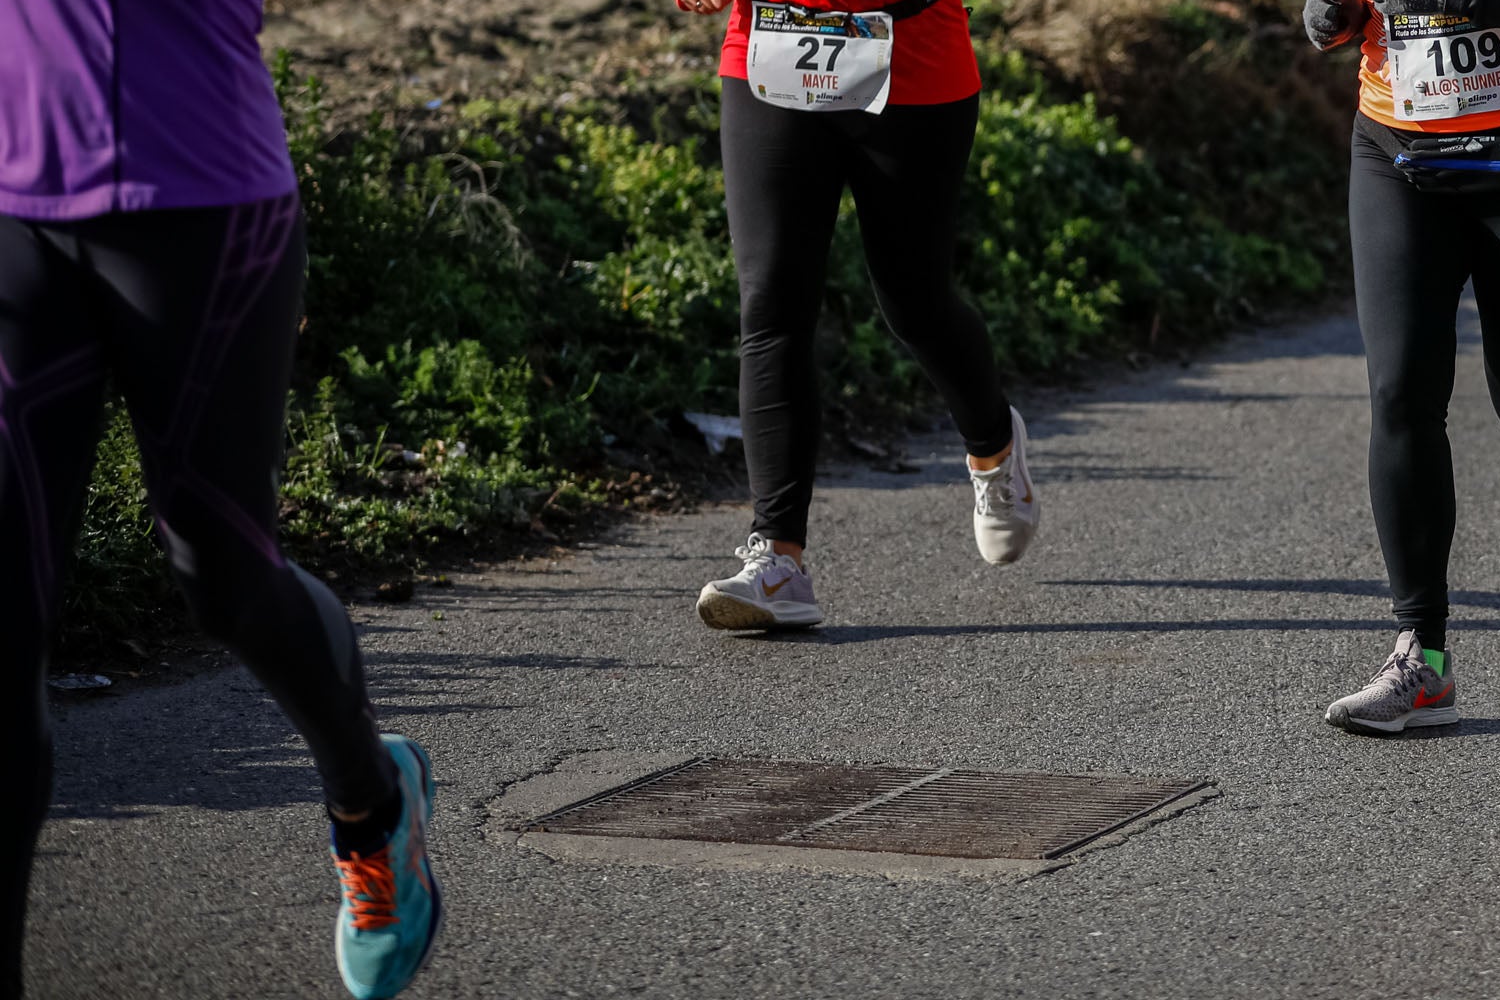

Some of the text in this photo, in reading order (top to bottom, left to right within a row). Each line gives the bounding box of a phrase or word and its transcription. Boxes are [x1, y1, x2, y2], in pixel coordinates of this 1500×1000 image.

[760, 8, 774, 18] 26
[1429, 16, 1470, 28] POPULA
[795, 36, 846, 72] 27
[802, 74, 838, 90] MAYTE
[1424, 78, 1460, 97] ILL@S
[816, 92, 843, 101] olimpo
[1468, 93, 1498, 103] olimpo
